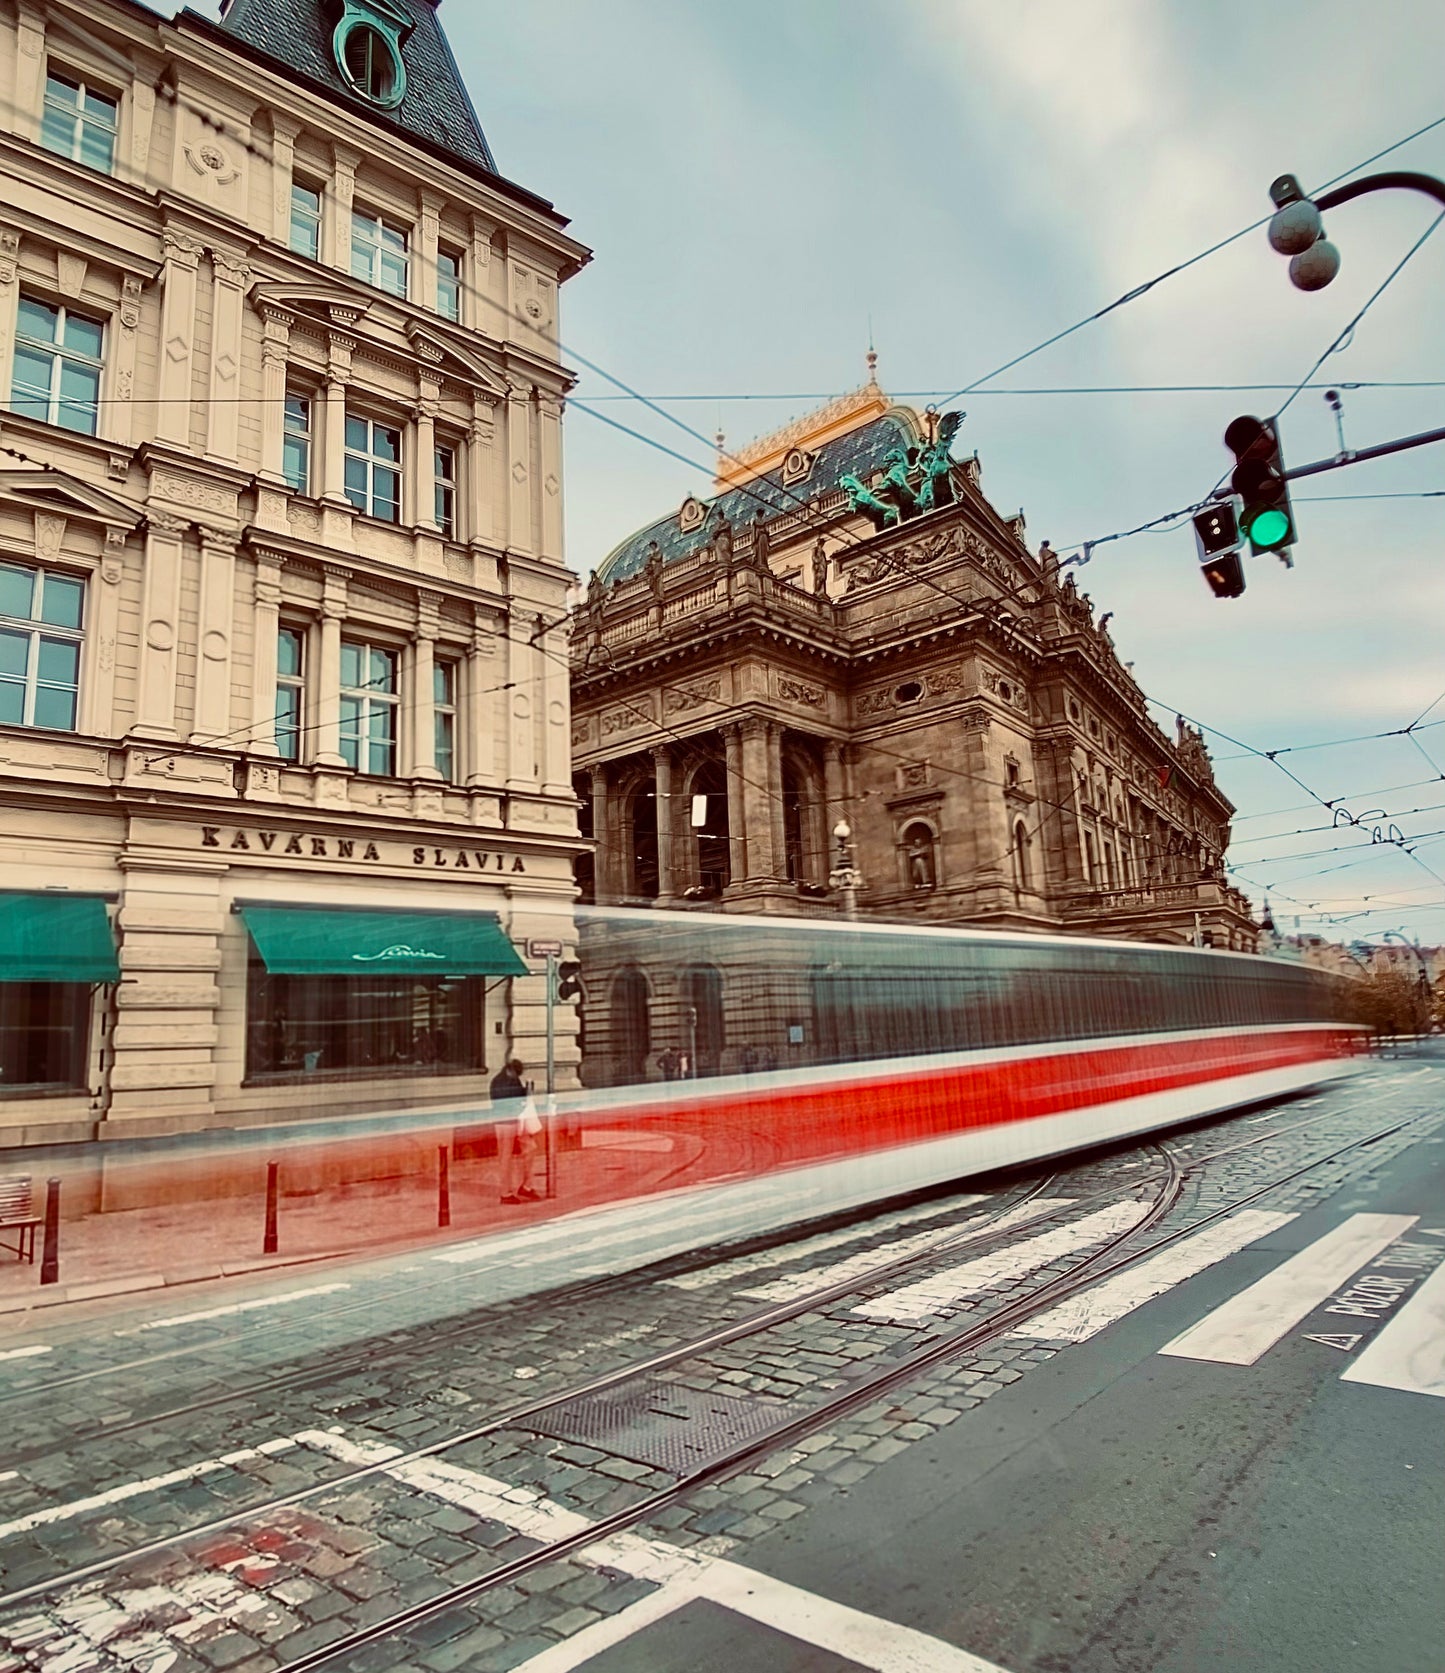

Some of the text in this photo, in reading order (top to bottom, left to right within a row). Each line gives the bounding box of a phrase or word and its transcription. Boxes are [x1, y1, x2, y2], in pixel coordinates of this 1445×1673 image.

[201, 826, 526, 873] KAVÁRNA SLAVIA
[1323, 1275, 1416, 1318] POZOR
